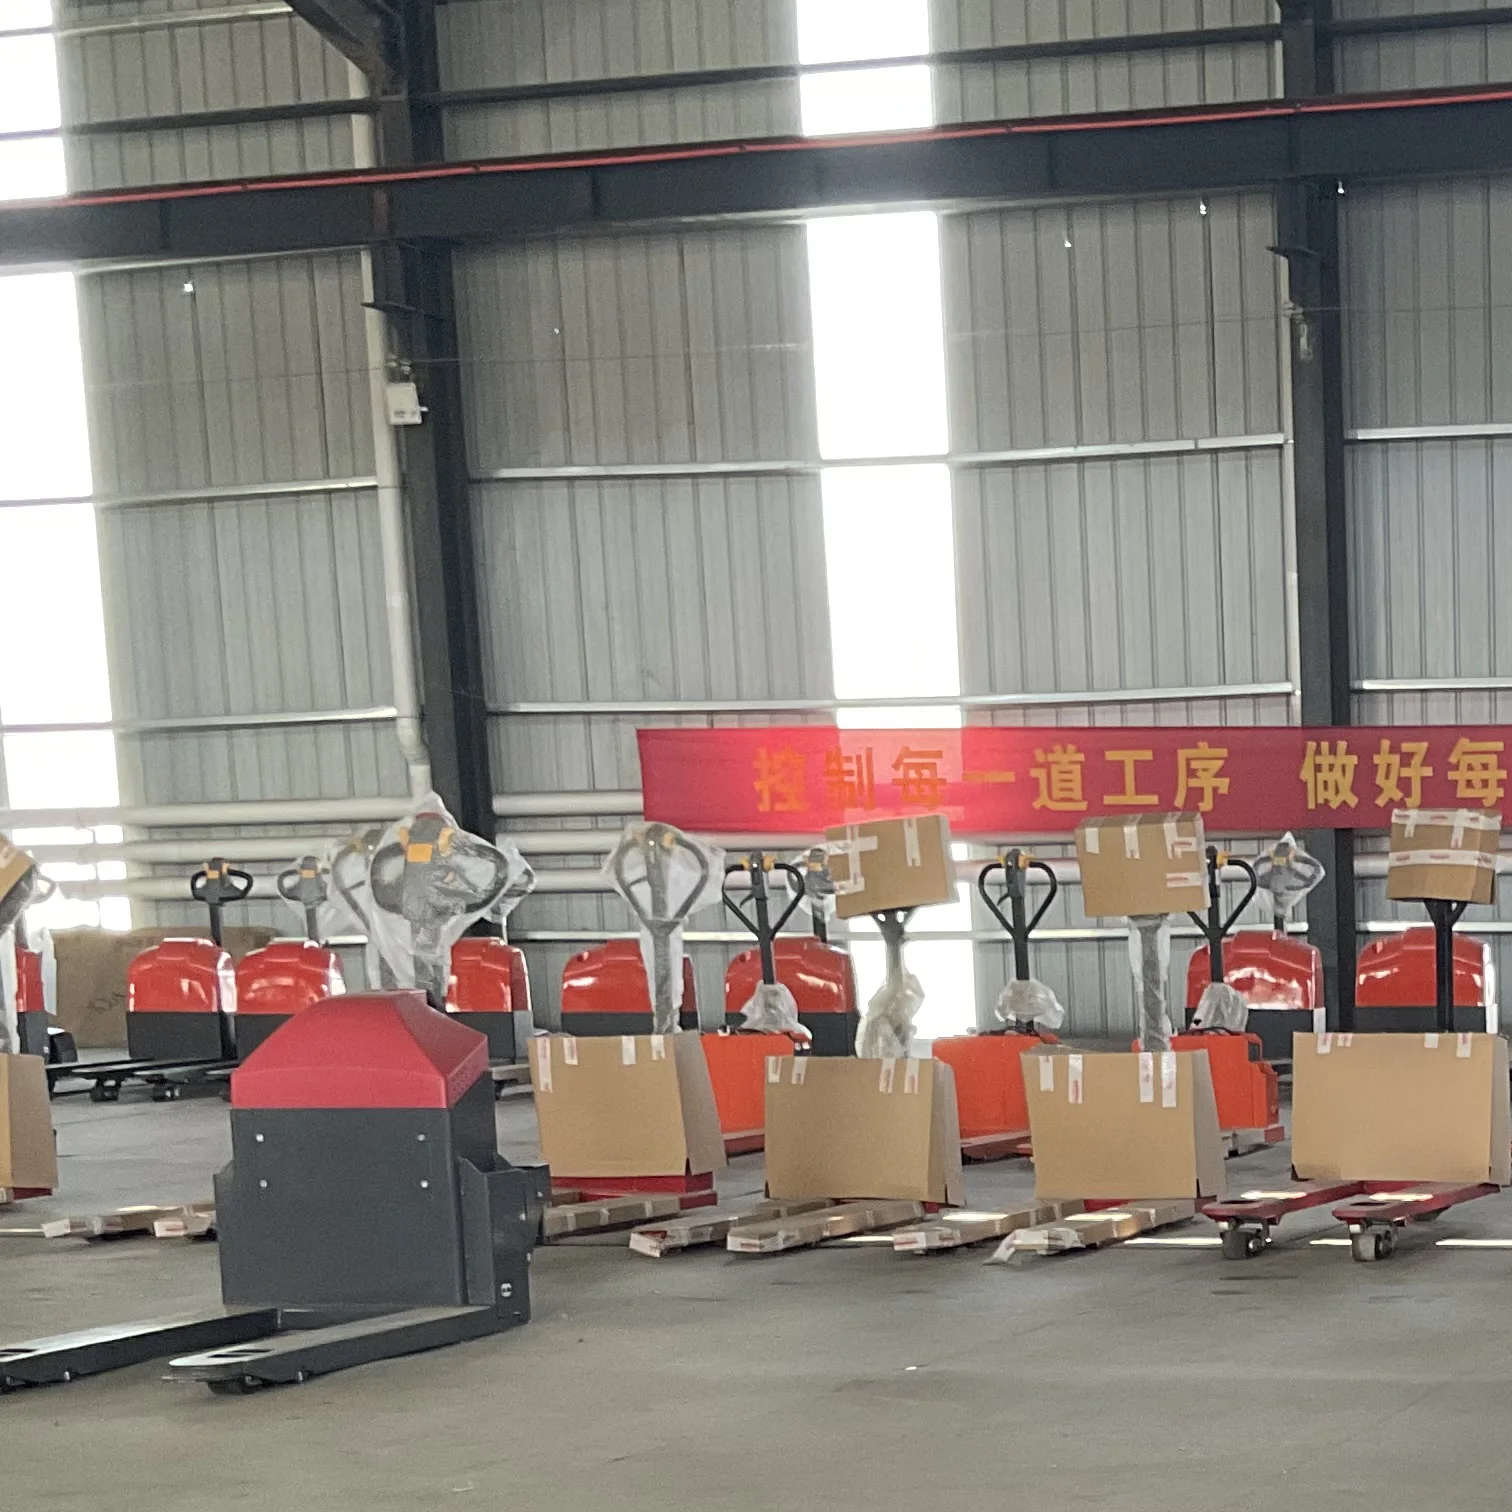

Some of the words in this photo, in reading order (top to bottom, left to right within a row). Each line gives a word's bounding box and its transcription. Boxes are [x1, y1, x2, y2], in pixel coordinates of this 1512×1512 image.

[753, 742, 1230, 812] 控制每一道工序
